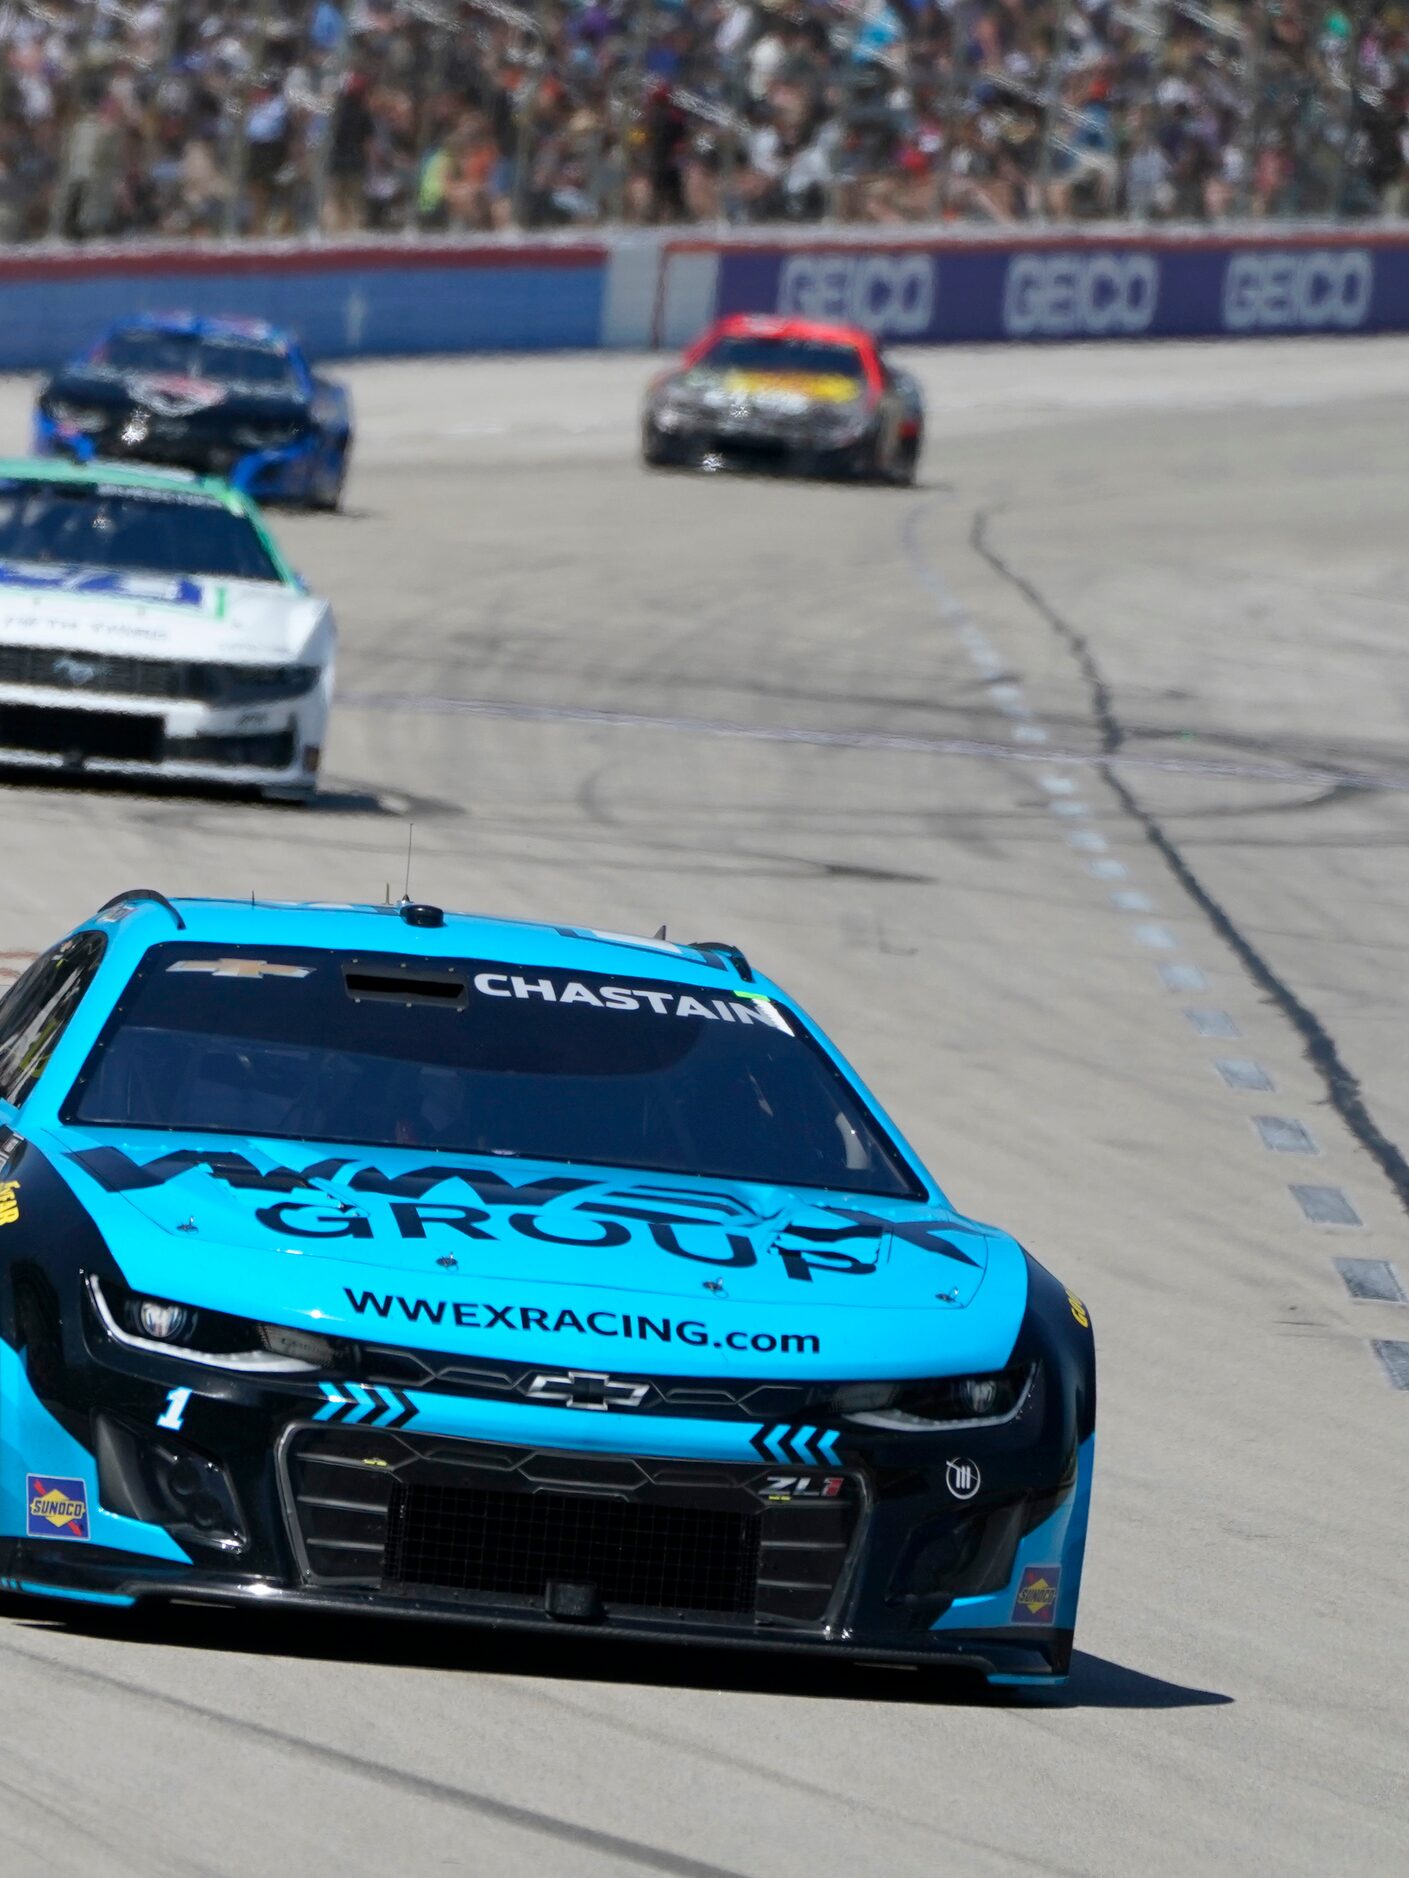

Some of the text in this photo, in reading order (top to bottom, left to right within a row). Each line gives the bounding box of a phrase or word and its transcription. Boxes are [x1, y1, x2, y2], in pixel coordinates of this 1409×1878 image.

[776, 253, 934, 335] GEICO
[1002, 253, 1158, 335] GEICO
[1221, 250, 1375, 332] GEICO
[473, 972, 782, 1028] CHASTAIN
[255, 1200, 878, 1282] GROUP
[342, 1287, 821, 1355] WWEXRACING.com
[157, 1386, 193, 1431] 1
[33, 1500, 83, 1517] SUNOCO
[758, 1477, 845, 1497] ZL1
